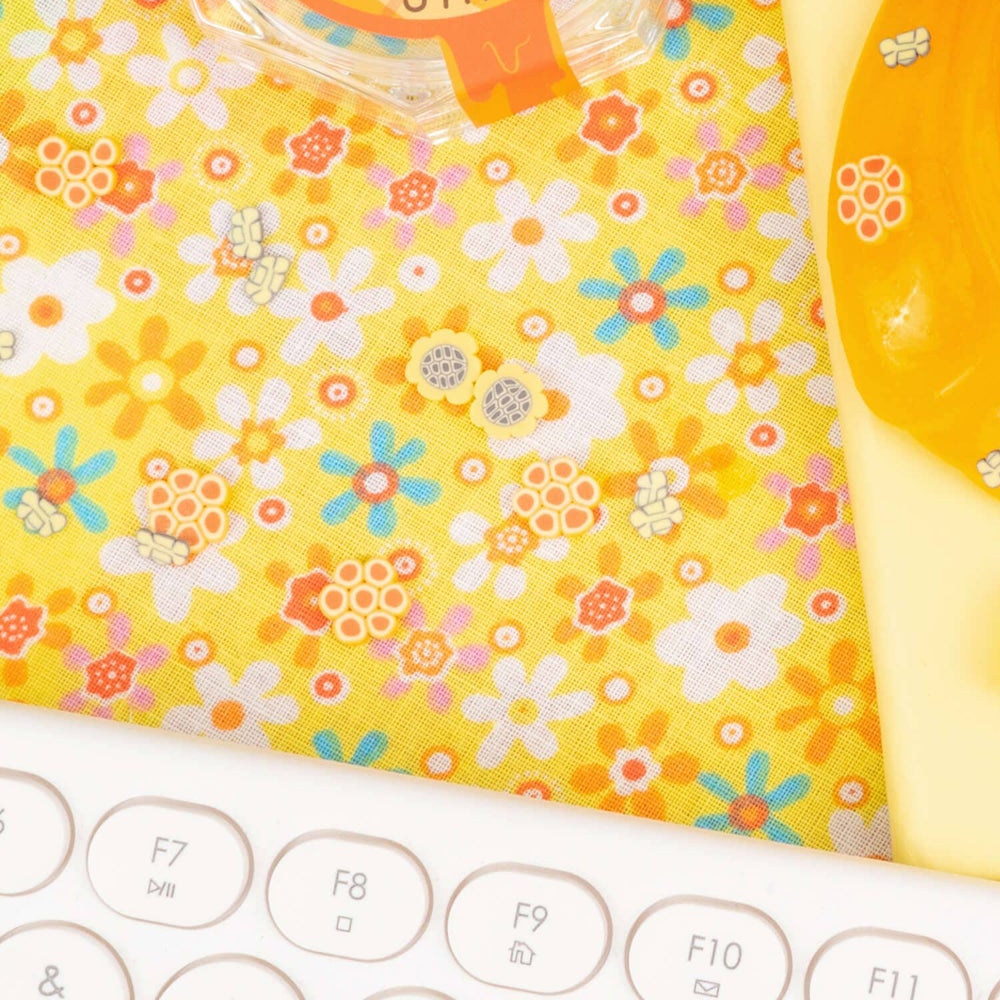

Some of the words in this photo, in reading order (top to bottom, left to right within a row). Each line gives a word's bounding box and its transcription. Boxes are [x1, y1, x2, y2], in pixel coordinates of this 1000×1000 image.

[151, 836, 189, 867] F7
[332, 869, 368, 901] F8
[513, 902, 549, 933] F9
[687, 934, 743, 971] F10
[868, 966, 919, 1000] F11
